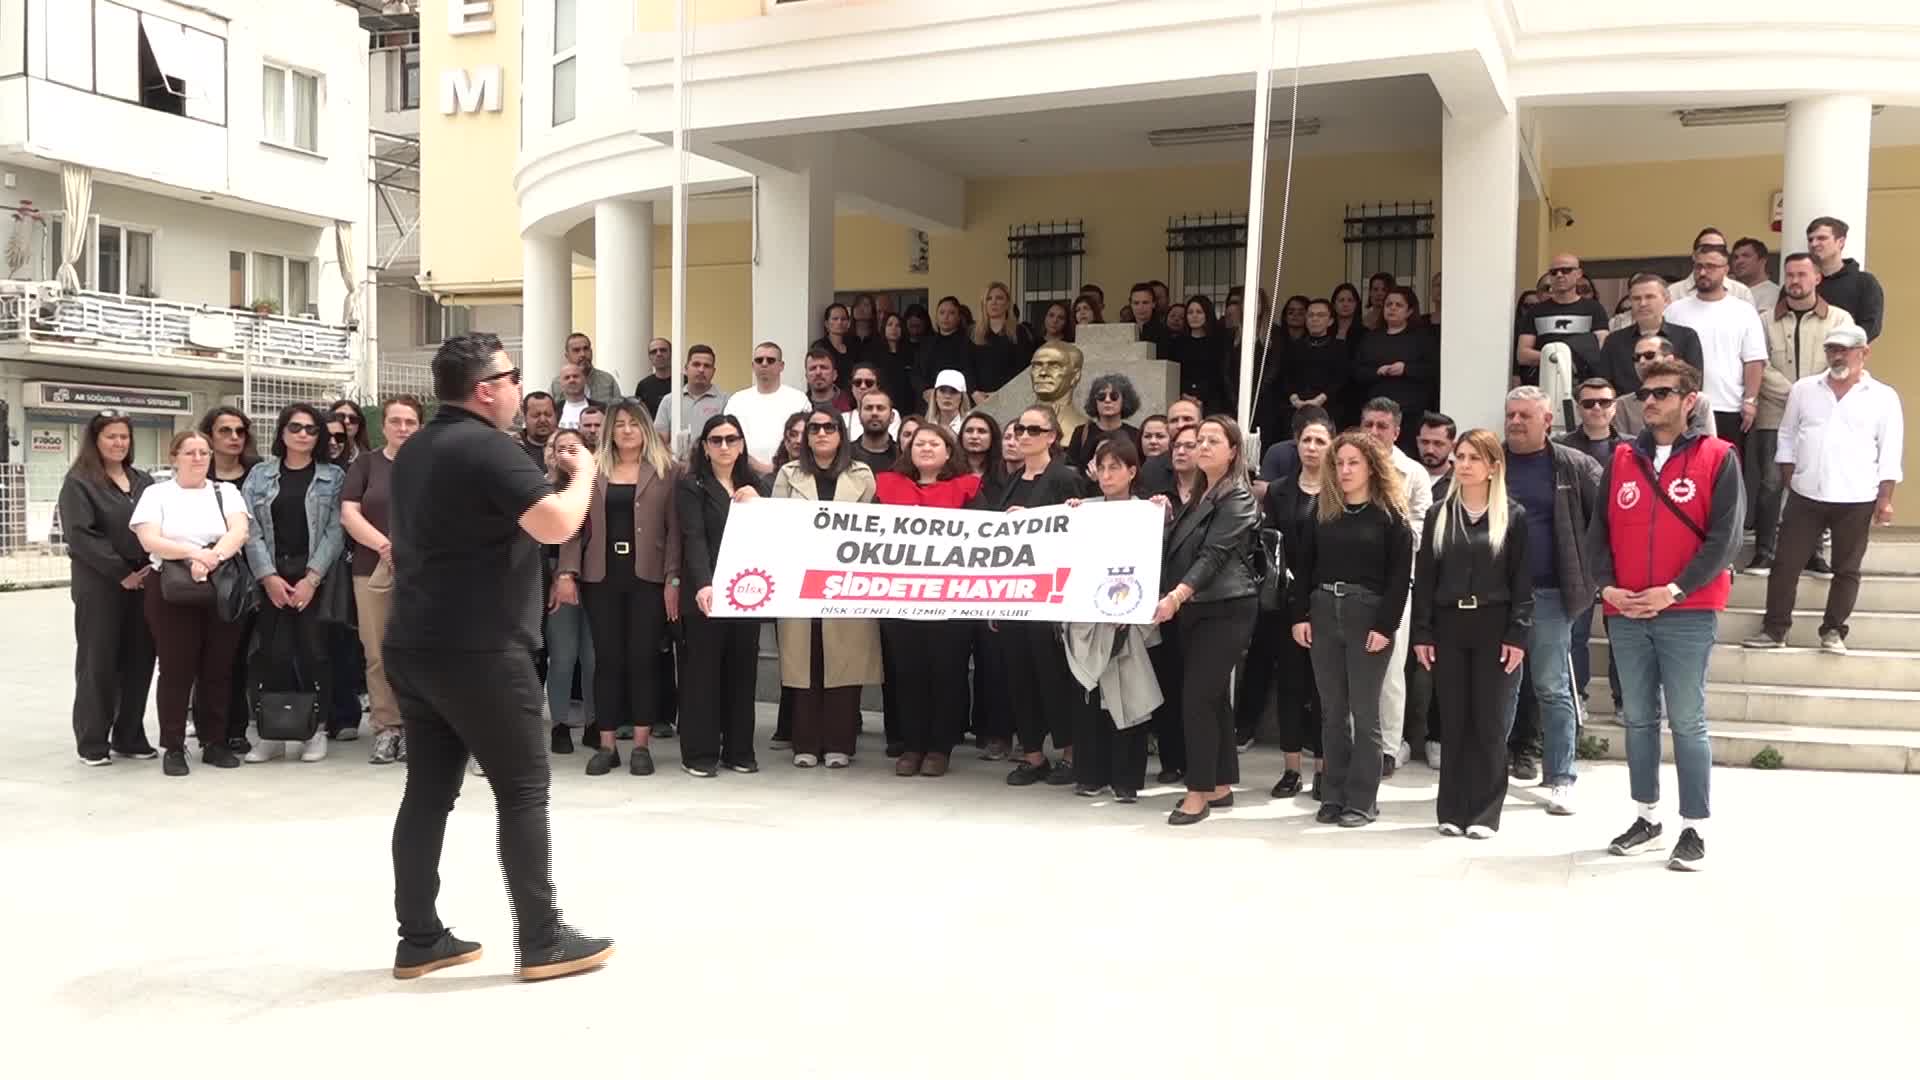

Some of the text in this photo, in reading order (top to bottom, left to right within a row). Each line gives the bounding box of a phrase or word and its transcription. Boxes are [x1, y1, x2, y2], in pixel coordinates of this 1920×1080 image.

[813, 507, 1070, 540] ÖNLE, KORU, CAYDIR
[836, 541, 1036, 568] OKULLARDA
[823, 572, 943, 600] ŞİDDETE
